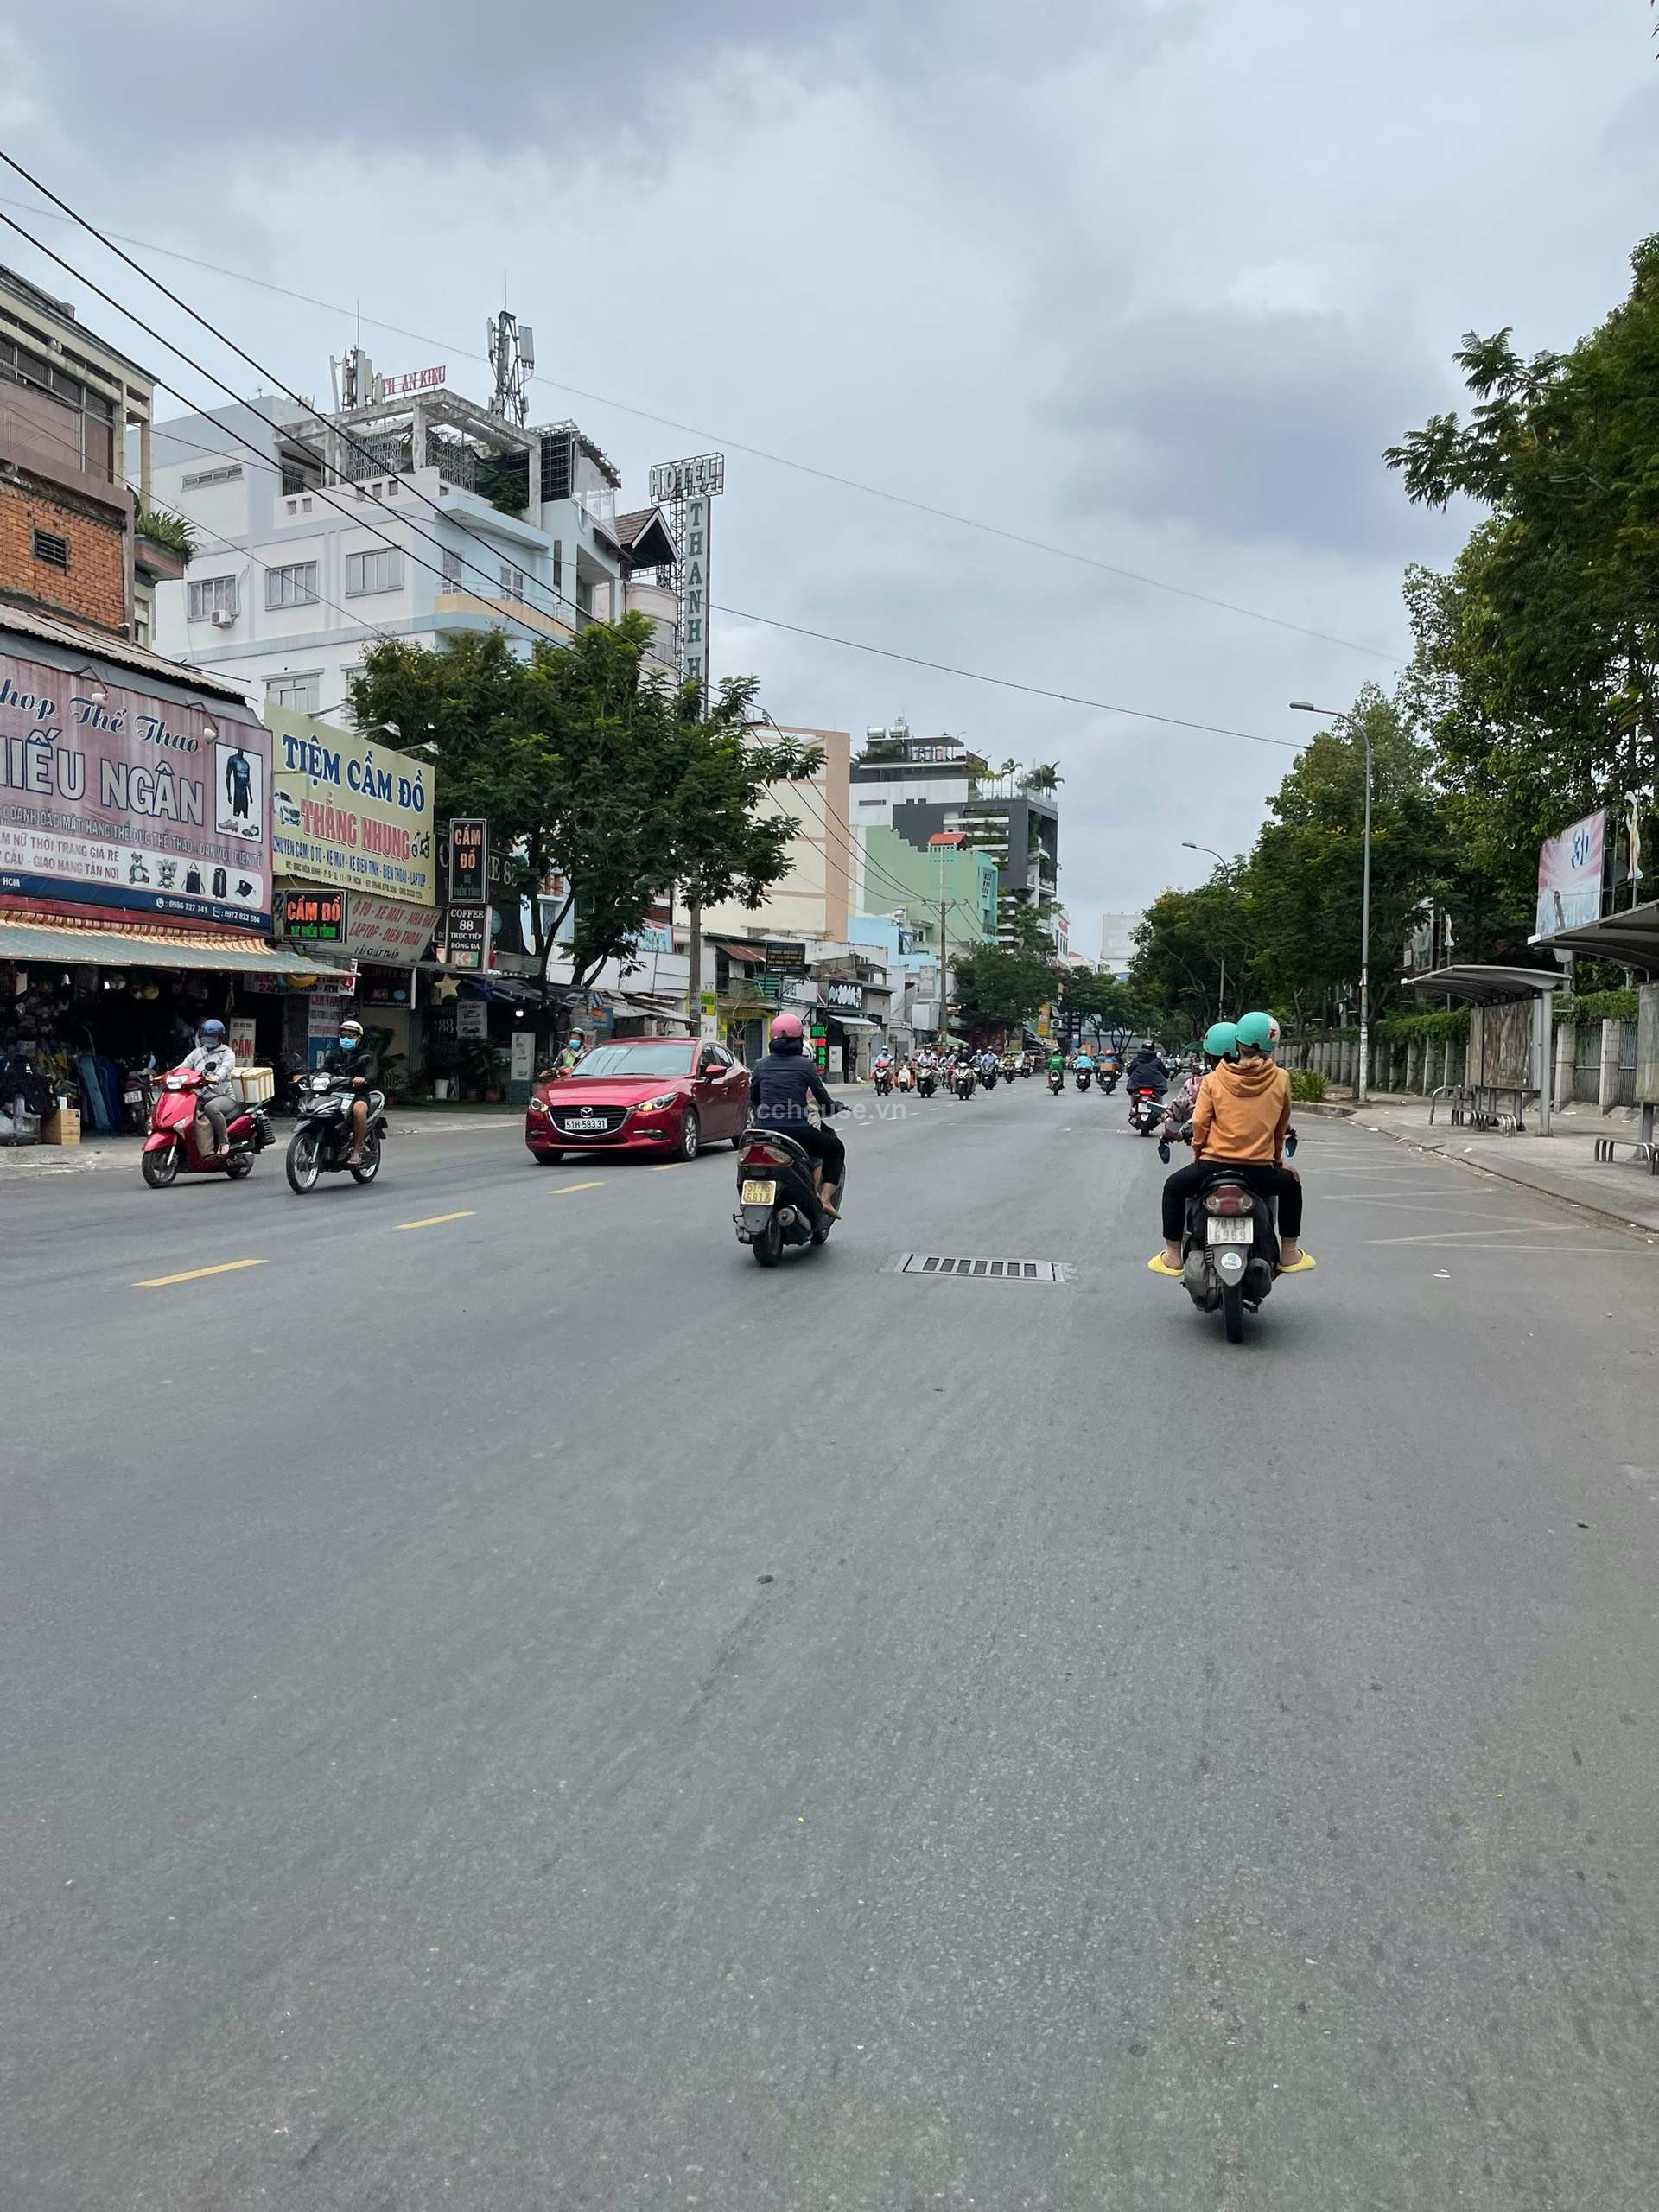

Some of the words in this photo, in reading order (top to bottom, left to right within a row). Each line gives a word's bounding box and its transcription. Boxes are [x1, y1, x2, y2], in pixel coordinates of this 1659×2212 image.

[649, 458, 716, 497] HOTEL
[688, 502, 703, 644] THANH
[69, 696, 127, 734] Thể
[133, 715, 201, 754] Thao
[0, 728, 85, 800] IẾU
[100, 760, 204, 826] NGÂN
[283, 734, 341, 786] TIỆM
[346, 750, 392, 803] CẦM
[398, 768, 425, 813] ĐỒ
[361, 817, 410, 862] NHUNG
[454, 823, 481, 846] CẦM
[56, 840, 87, 857] TRANG
[460, 848, 476, 868] ĐỒ
[33, 855, 54, 870] GIAO
[287, 895, 317, 921] CẦM
[321, 896, 340, 922] ĐỒ
[450, 909, 484, 919] COFFEE
[348, 922, 380, 939] LAPTOP
[459, 920, 474, 931] 88
